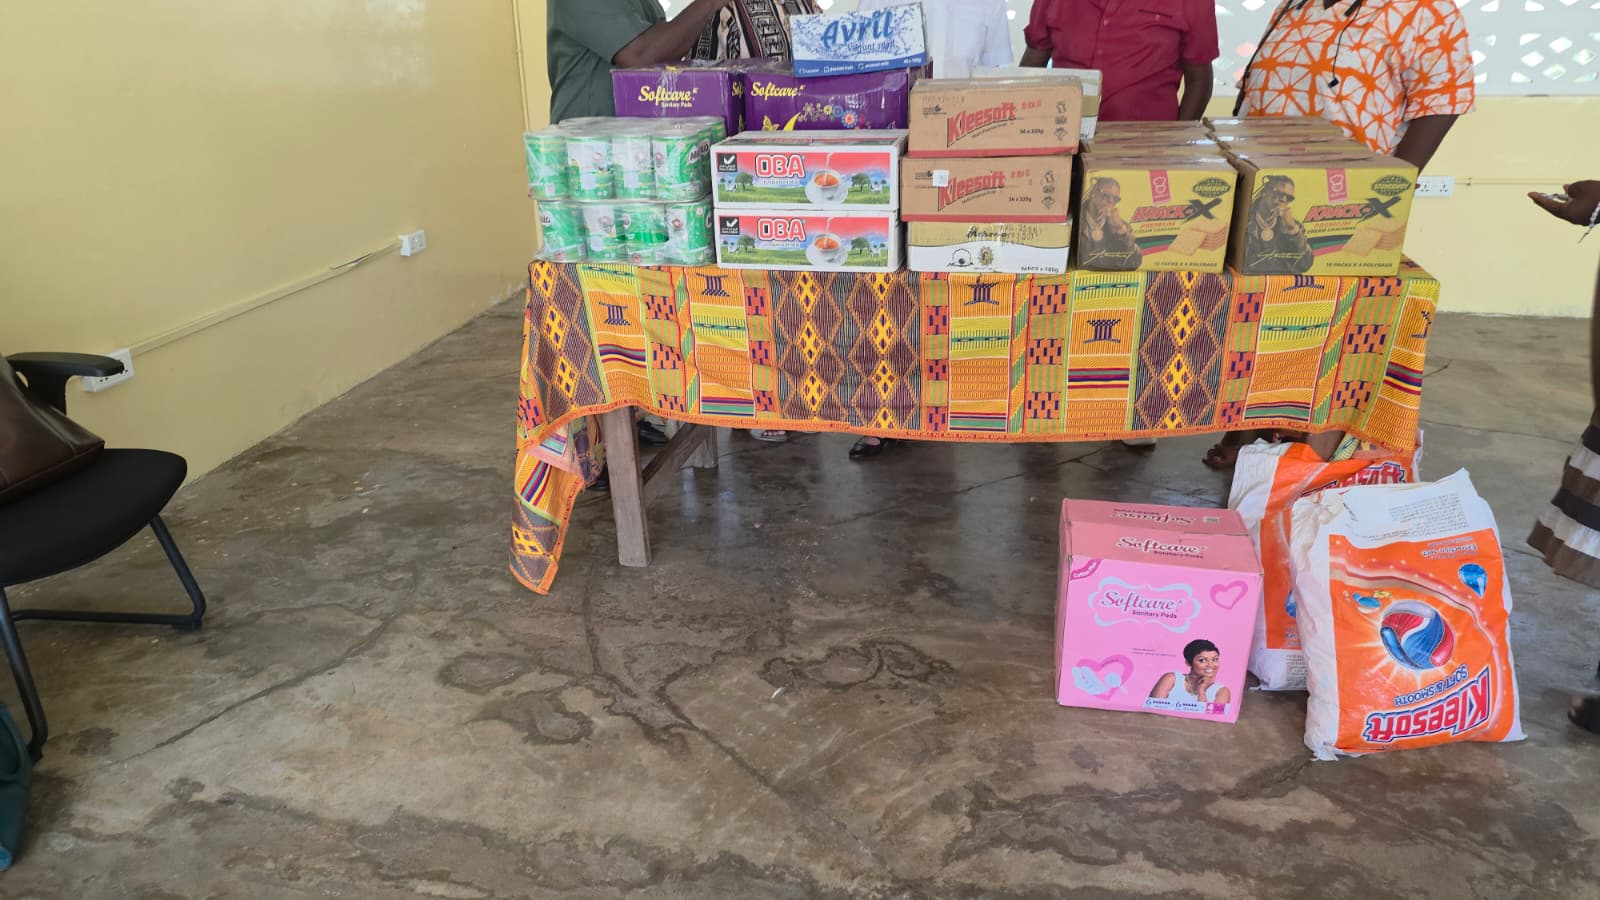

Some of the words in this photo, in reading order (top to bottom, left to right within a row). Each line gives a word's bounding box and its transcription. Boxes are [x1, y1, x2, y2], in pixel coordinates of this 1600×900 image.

[820, 9, 895, 49] Avril
[638, 85, 692, 106] Softcare
[751, 81, 798, 101] Softcare
[948, 102, 1017, 147] Kleesoft
[755, 153, 806, 178] OBA
[938, 170, 1006, 211] Kleesoft
[757, 218, 807, 241] OBA
[1116, 536, 1199, 552] Softcare
[1101, 591, 1177, 611] Softcare
[1132, 609, 1160, 618] Sanitary
[1160, 611, 1178, 619] Pads
[1445, 664, 1469, 690] SOFT
[1363, 666, 1490, 742] Kleesoft
[1394, 684, 1437, 706] SMOOTH
